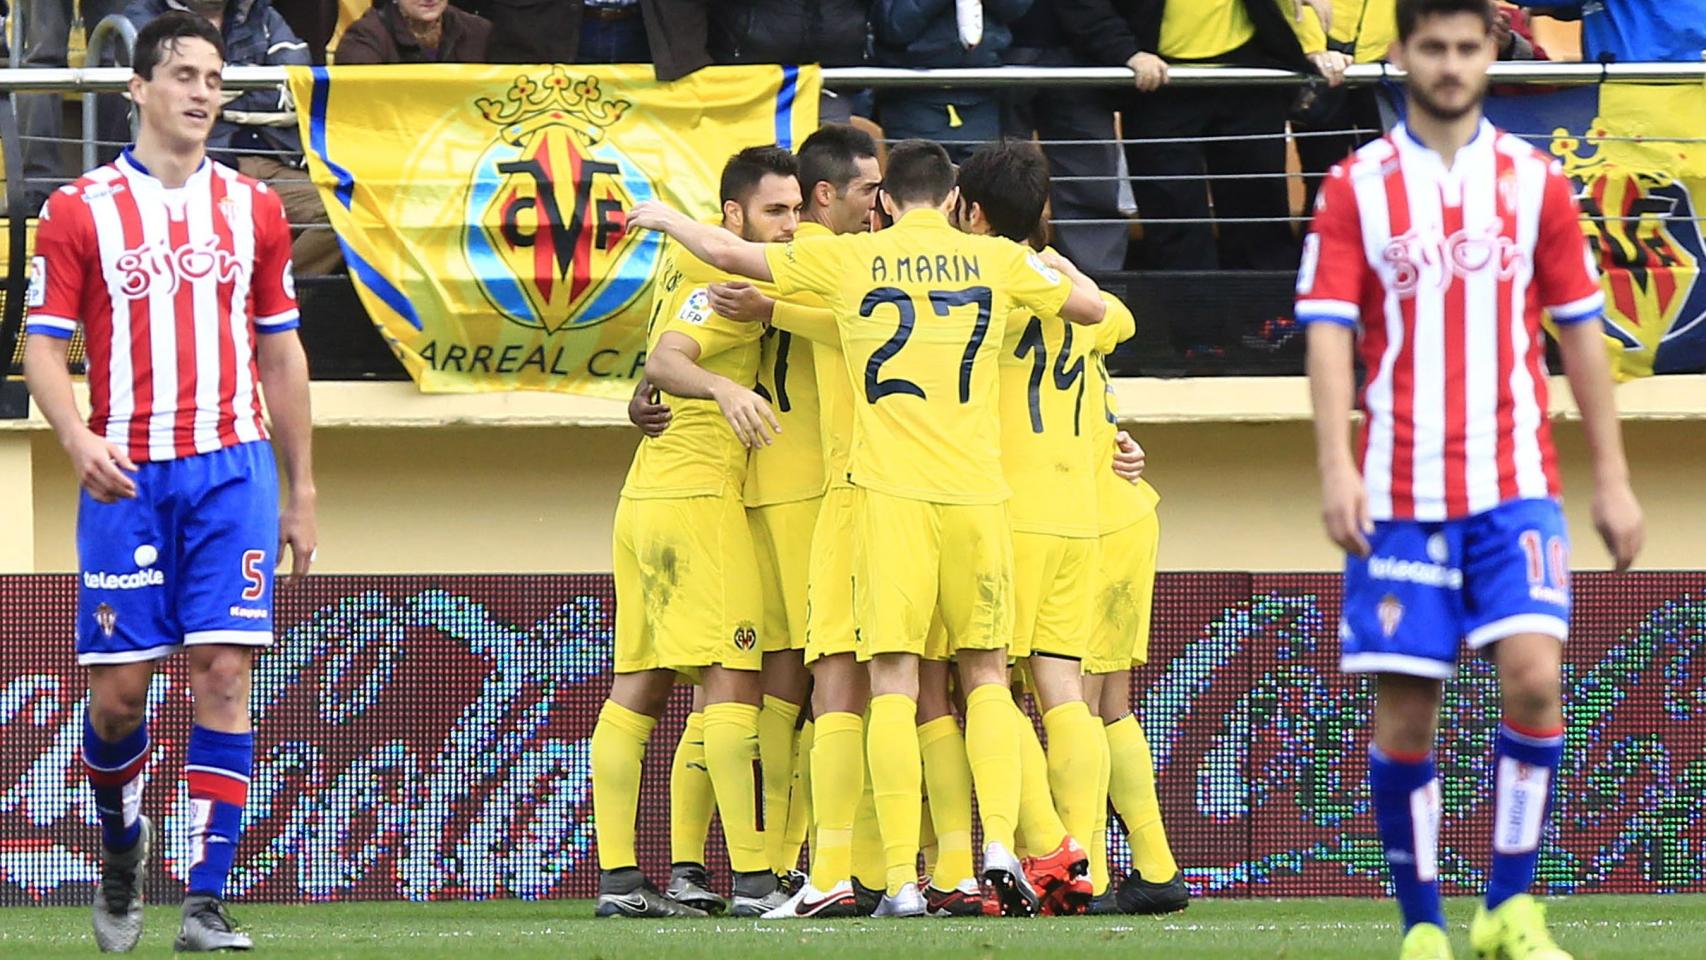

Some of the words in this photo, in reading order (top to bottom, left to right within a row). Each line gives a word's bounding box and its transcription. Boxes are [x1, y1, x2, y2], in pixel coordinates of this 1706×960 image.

[419, 339, 568, 376] ARREAL
[858, 286, 992, 405] 27
[1014, 315, 1085, 437] 14
[83, 568, 164, 590] telecable
[241, 549, 266, 601] 5
[1518, 529, 1570, 589] 10
